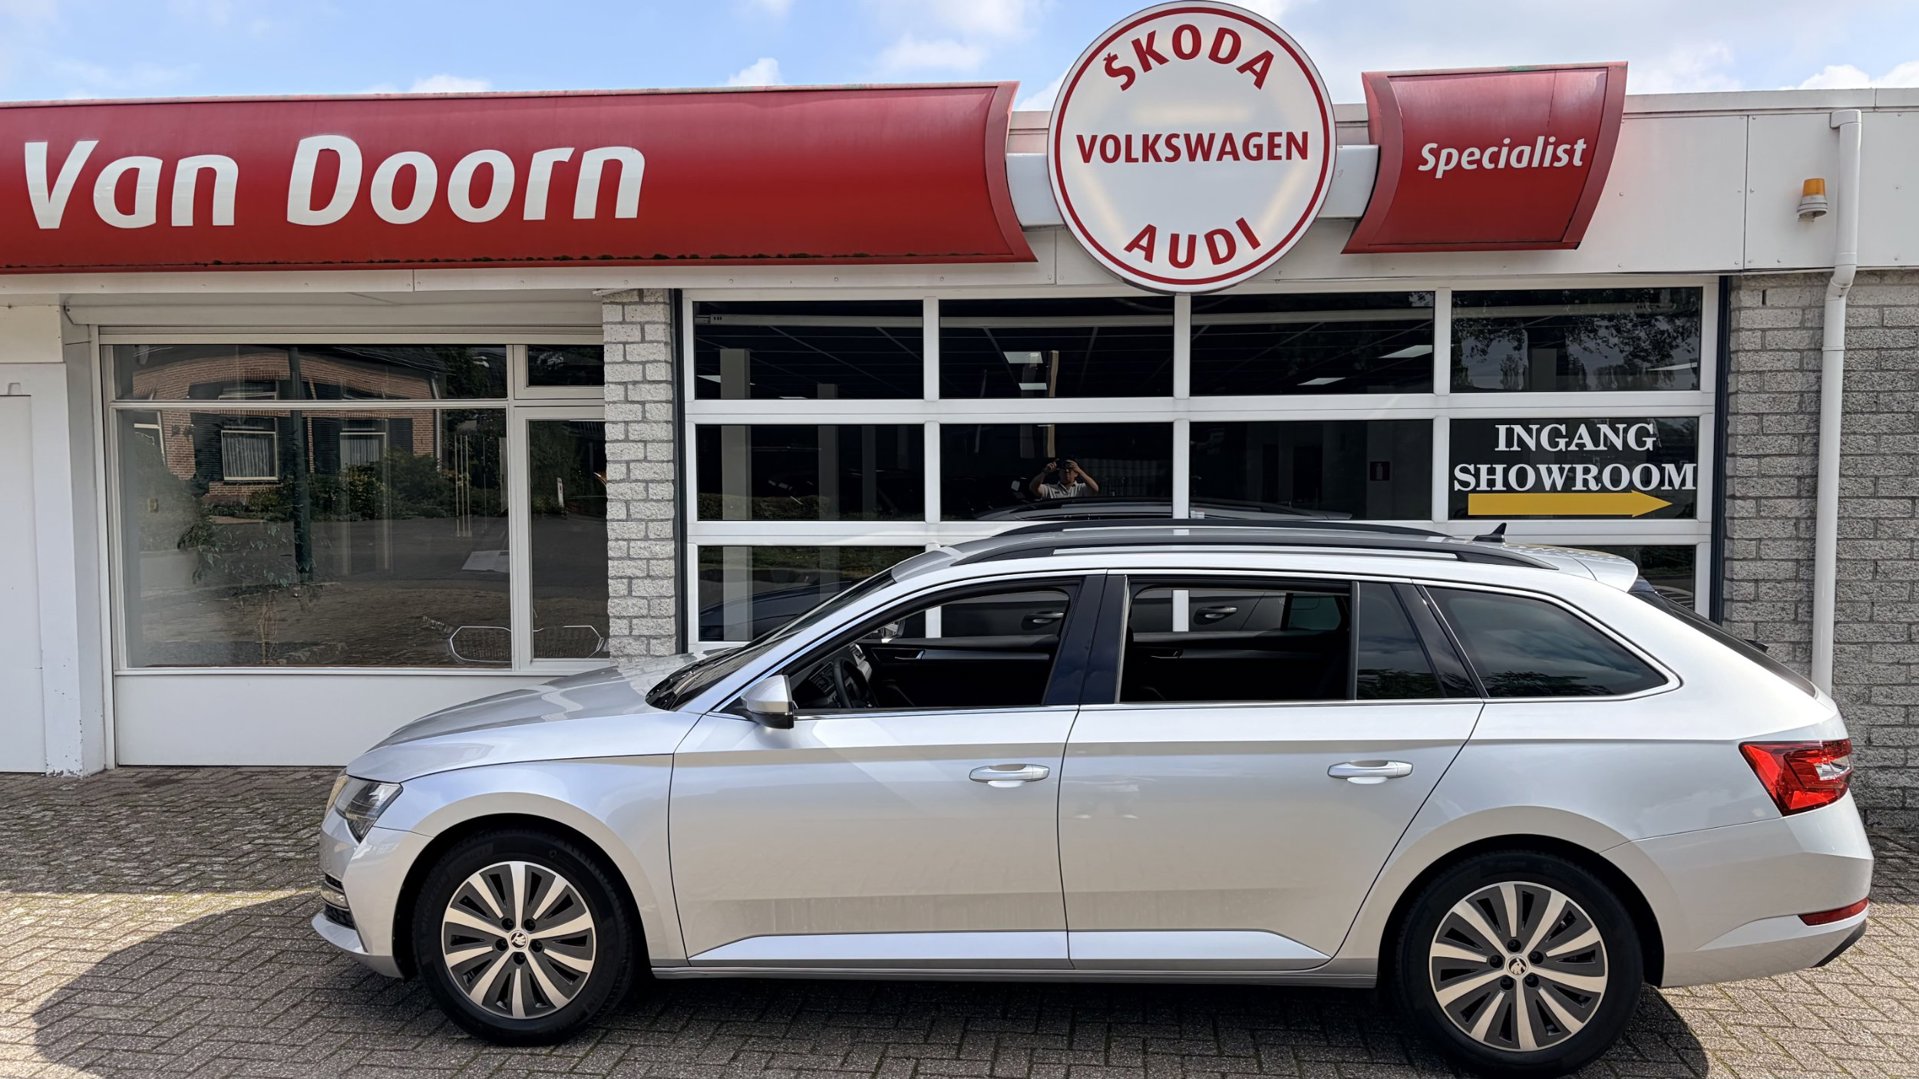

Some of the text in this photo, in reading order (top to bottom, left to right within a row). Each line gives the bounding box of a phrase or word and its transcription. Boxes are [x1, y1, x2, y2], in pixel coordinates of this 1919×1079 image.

[1104, 23, 1275, 91] ŠKODA
[1077, 131, 1308, 163] VOLKSWAGEN
[1418, 136, 1586, 178] Specialist
[25, 134, 645, 229] Van Doorn
[1124, 216, 1262, 268] AUDI
[1495, 423, 1656, 451] INGANG
[1454, 463, 1697, 492] SHOWROOM
